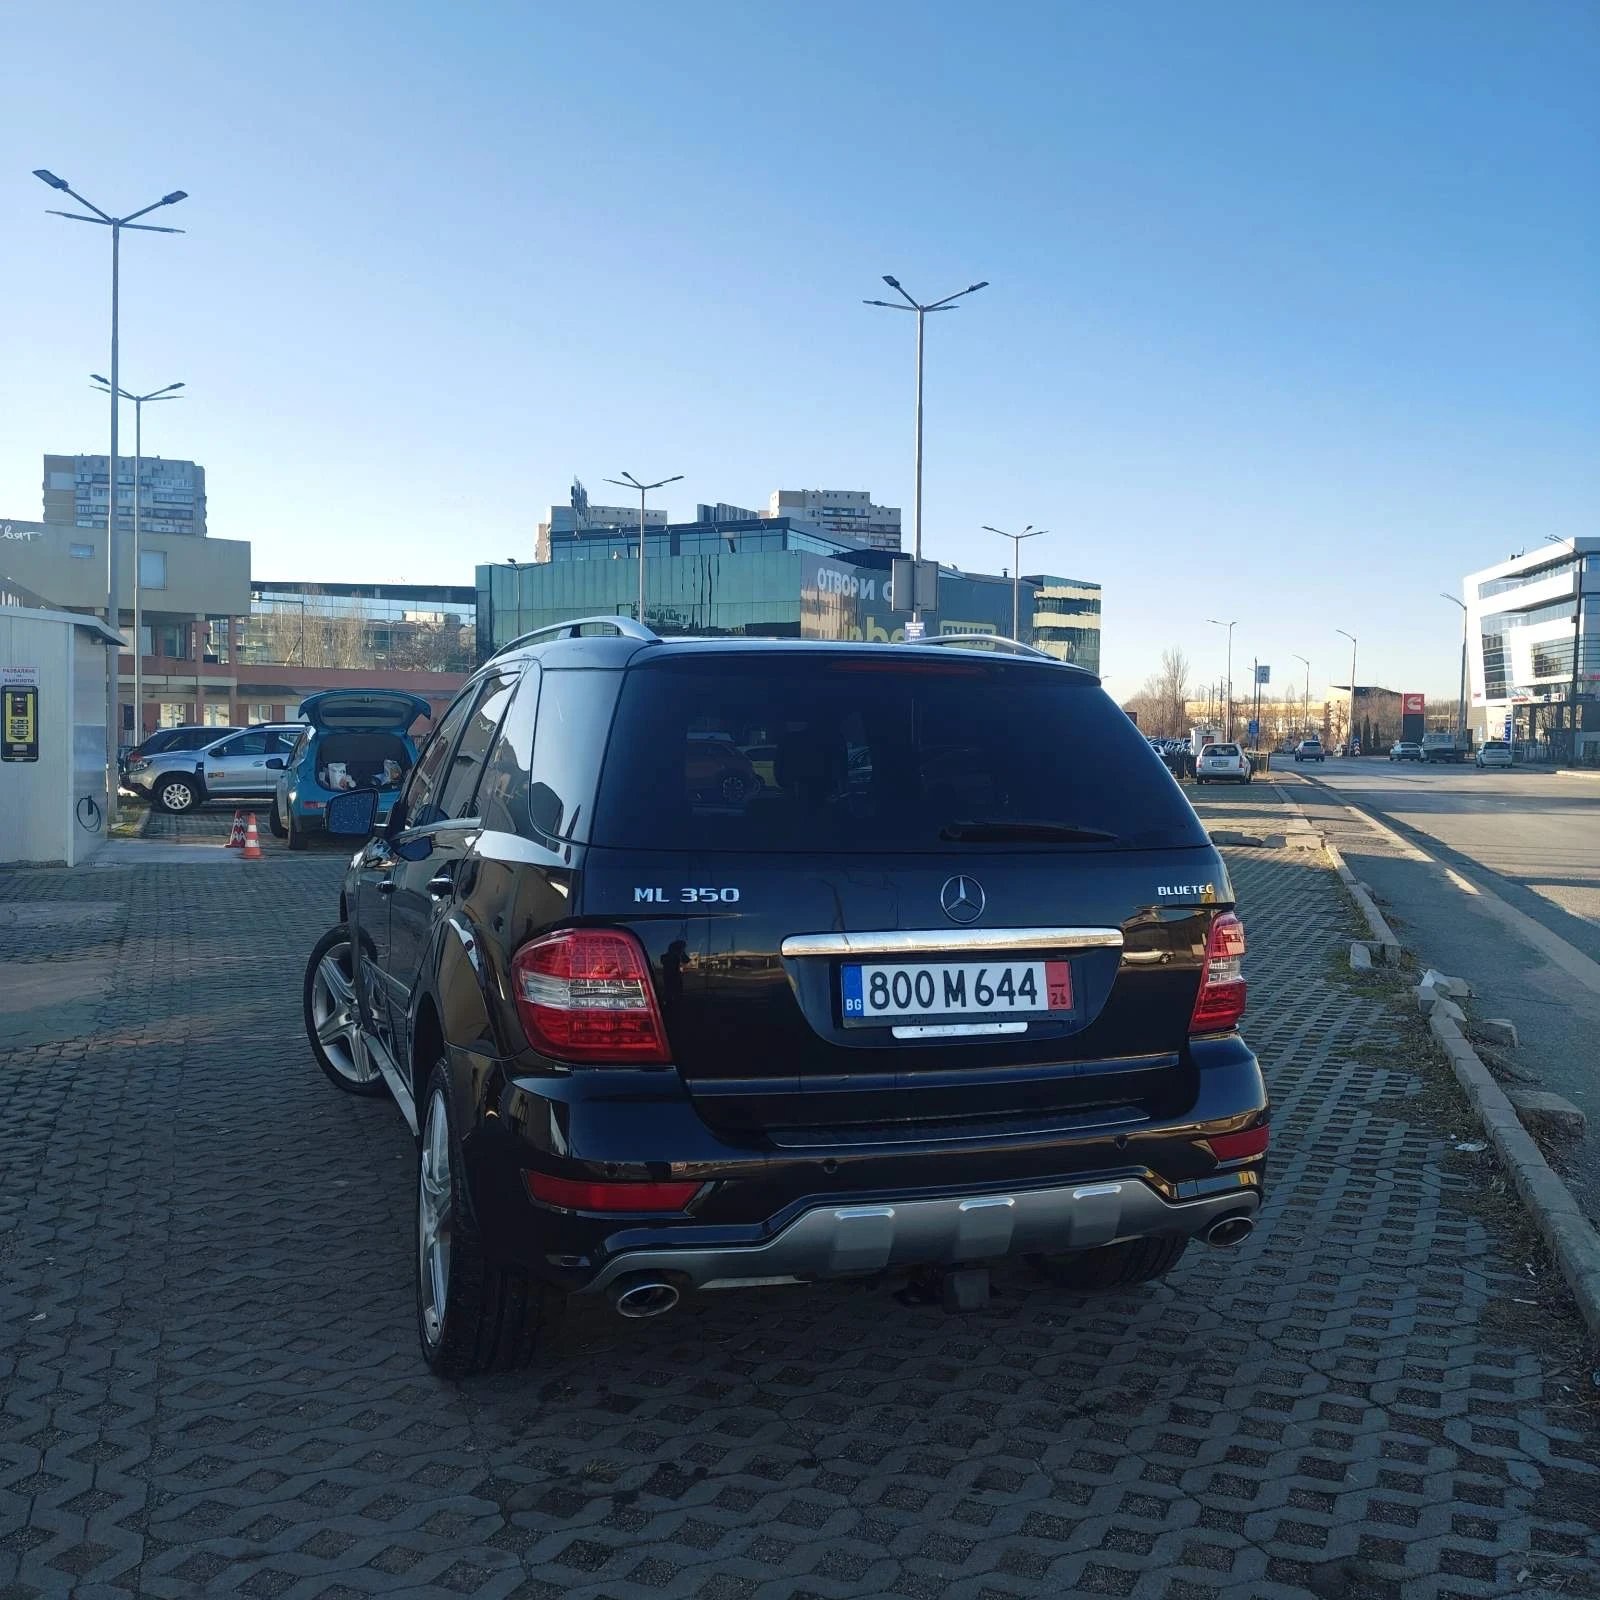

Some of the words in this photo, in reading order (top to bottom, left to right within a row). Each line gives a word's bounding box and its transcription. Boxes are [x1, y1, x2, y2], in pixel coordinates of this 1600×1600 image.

[817, 567, 875, 601] ОТВОРИ
[633, 887, 670, 903] ML
[680, 887, 740, 903] 350
[1157, 884, 1214, 896] BLUETEC
[845, 998, 862, 1011] BG
